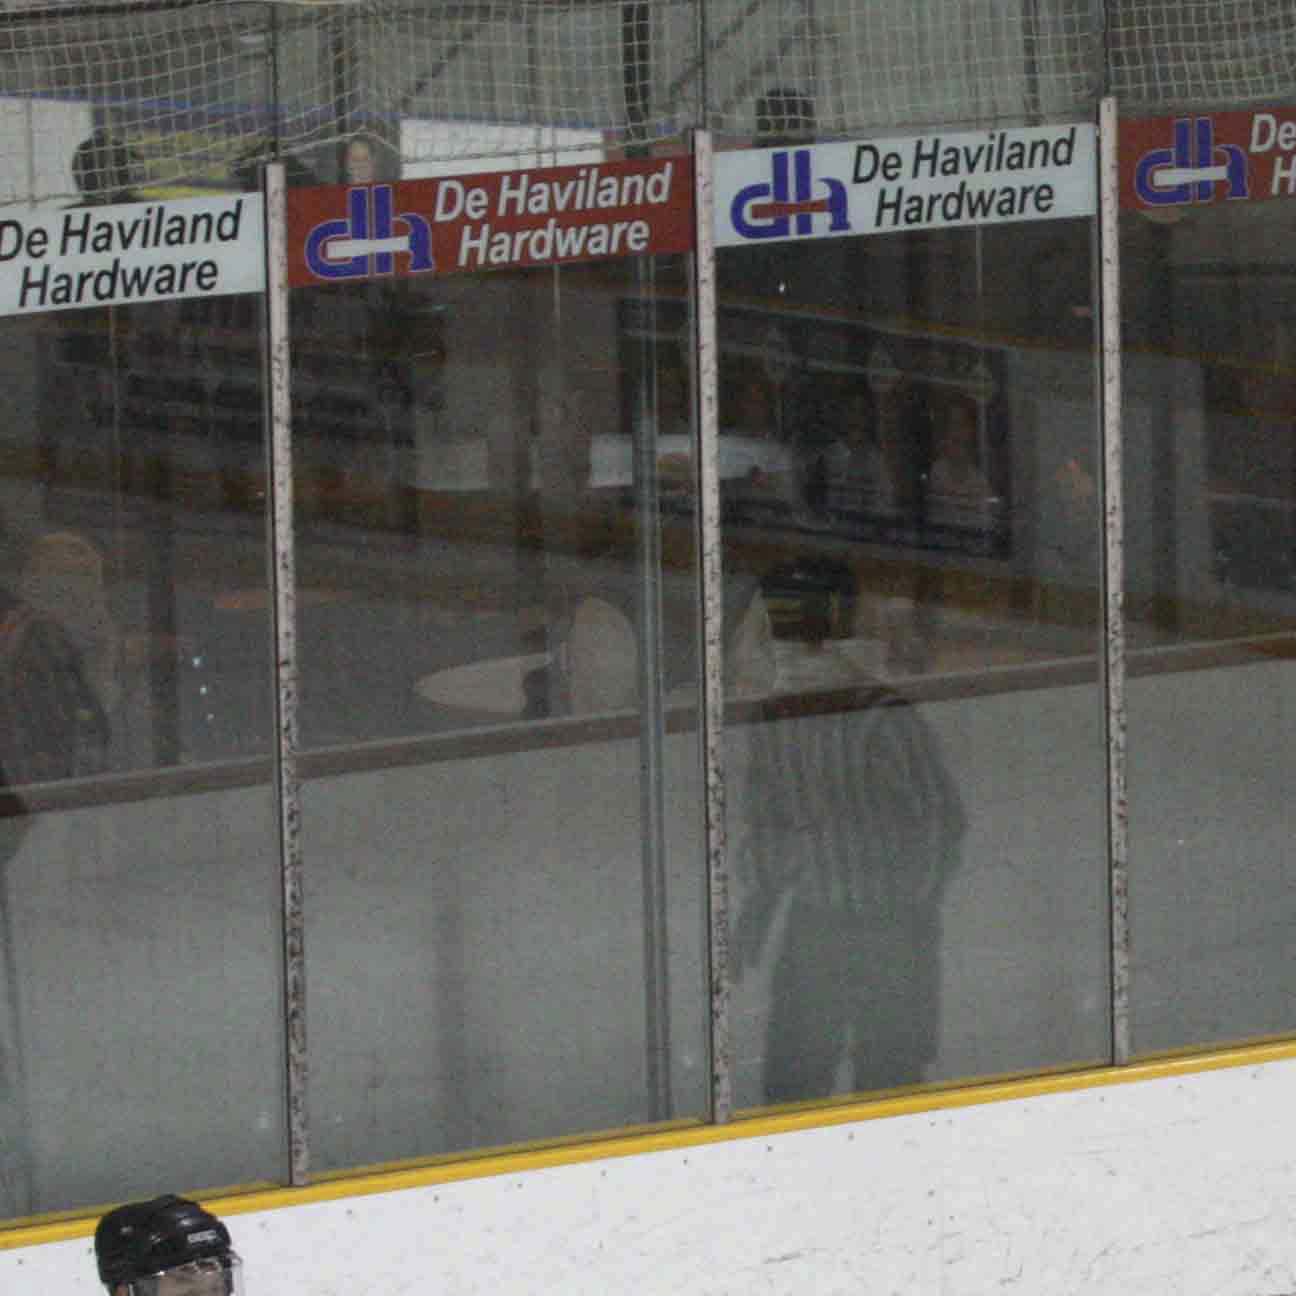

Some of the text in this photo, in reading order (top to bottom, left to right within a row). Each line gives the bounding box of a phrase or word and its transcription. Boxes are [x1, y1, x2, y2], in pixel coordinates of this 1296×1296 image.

[852, 127, 1075, 185] De Haviland
[434, 164, 672, 222] De Haviland
[875, 181, 1053, 227] Hardware
[0, 201, 241, 262] De Haviland
[458, 217, 648, 266] Hardware
[19, 257, 218, 307] Hardware
